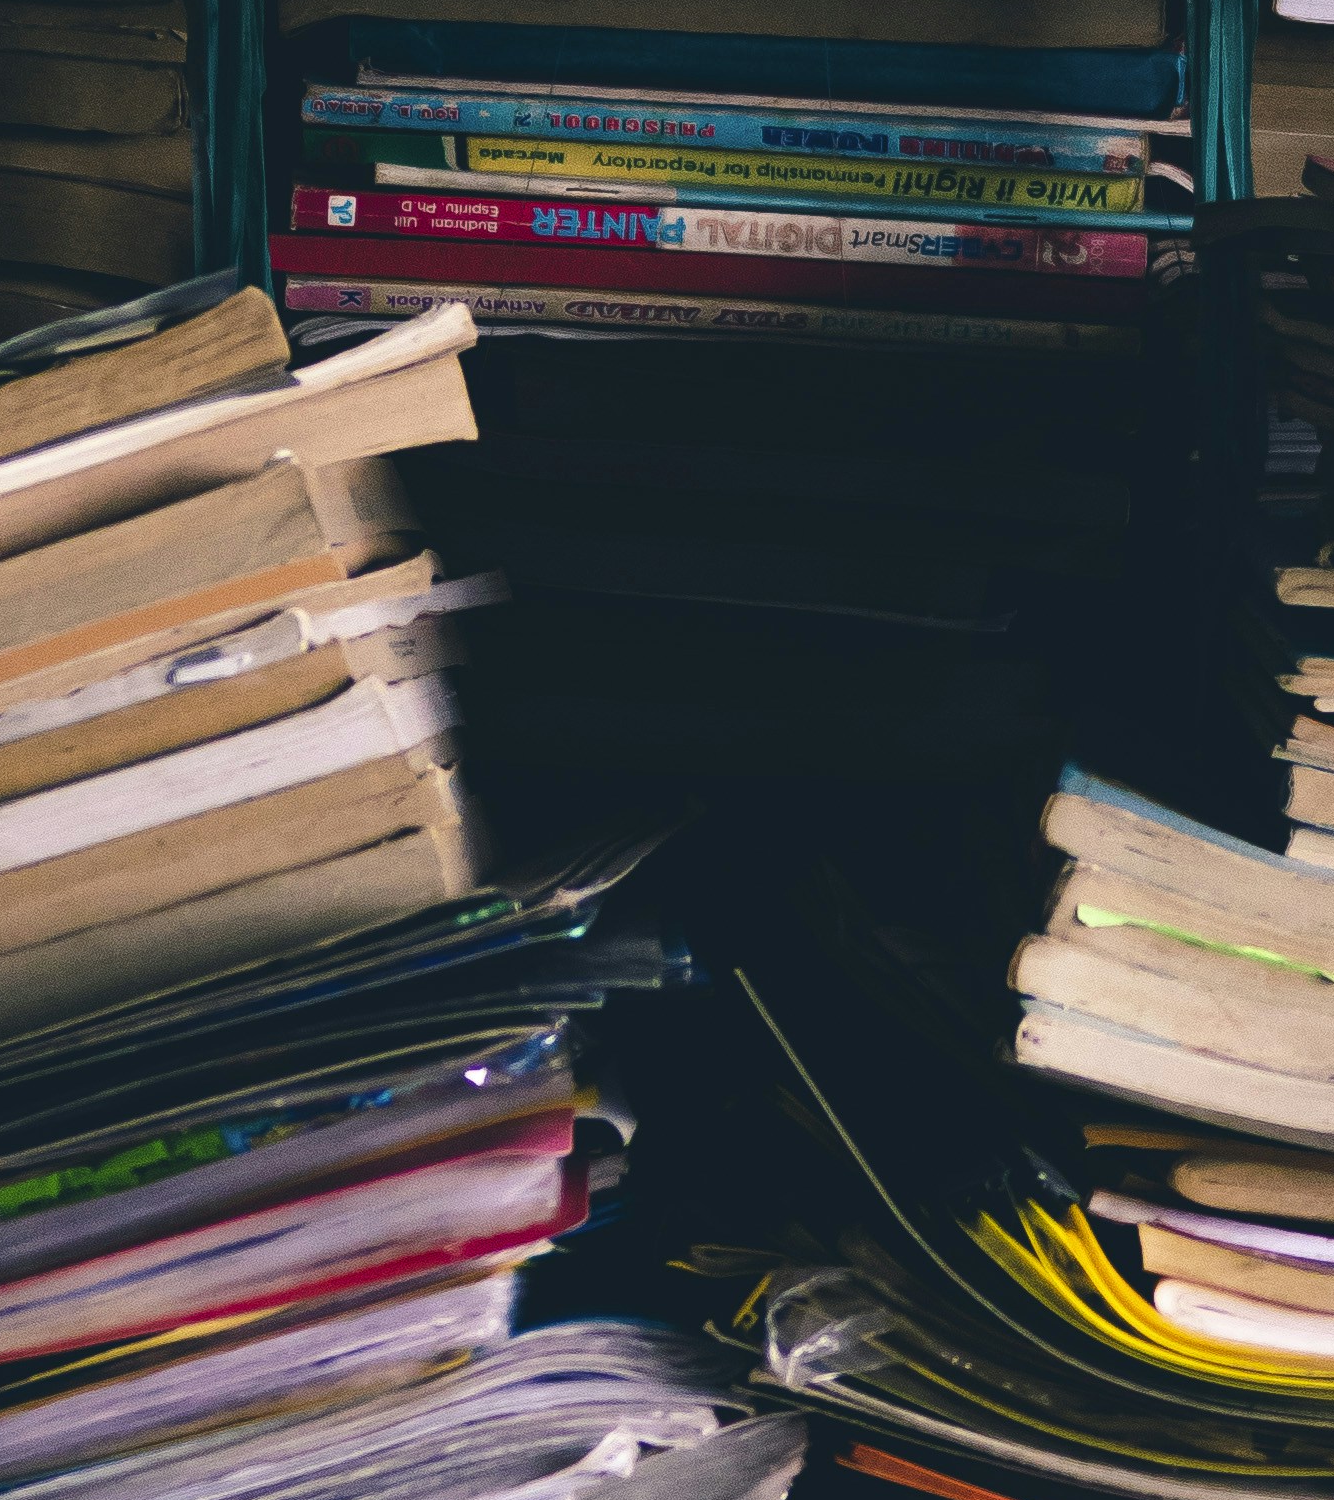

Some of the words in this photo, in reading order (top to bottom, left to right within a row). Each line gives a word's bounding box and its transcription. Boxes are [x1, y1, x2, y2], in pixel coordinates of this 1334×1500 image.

[420, 106, 460, 122] LOU
[546, 112, 716, 139] PRESCHOOL
[478, 148, 565, 165] Mercado
[592, 153, 717, 177] Preparatory
[723, 162, 750, 180] for
[756, 160, 886, 188] Penmanship
[892, 168, 986, 202] Right!
[995, 178, 1016, 202] it
[1025, 179, 1108, 209] Write
[430, 217, 499, 234] Budhrani
[530, 206, 687, 245] PAINTER
[696, 218, 843, 256] DIGITAL
[385, 294, 433, 311] Book
[475, 296, 547, 315] Activity
